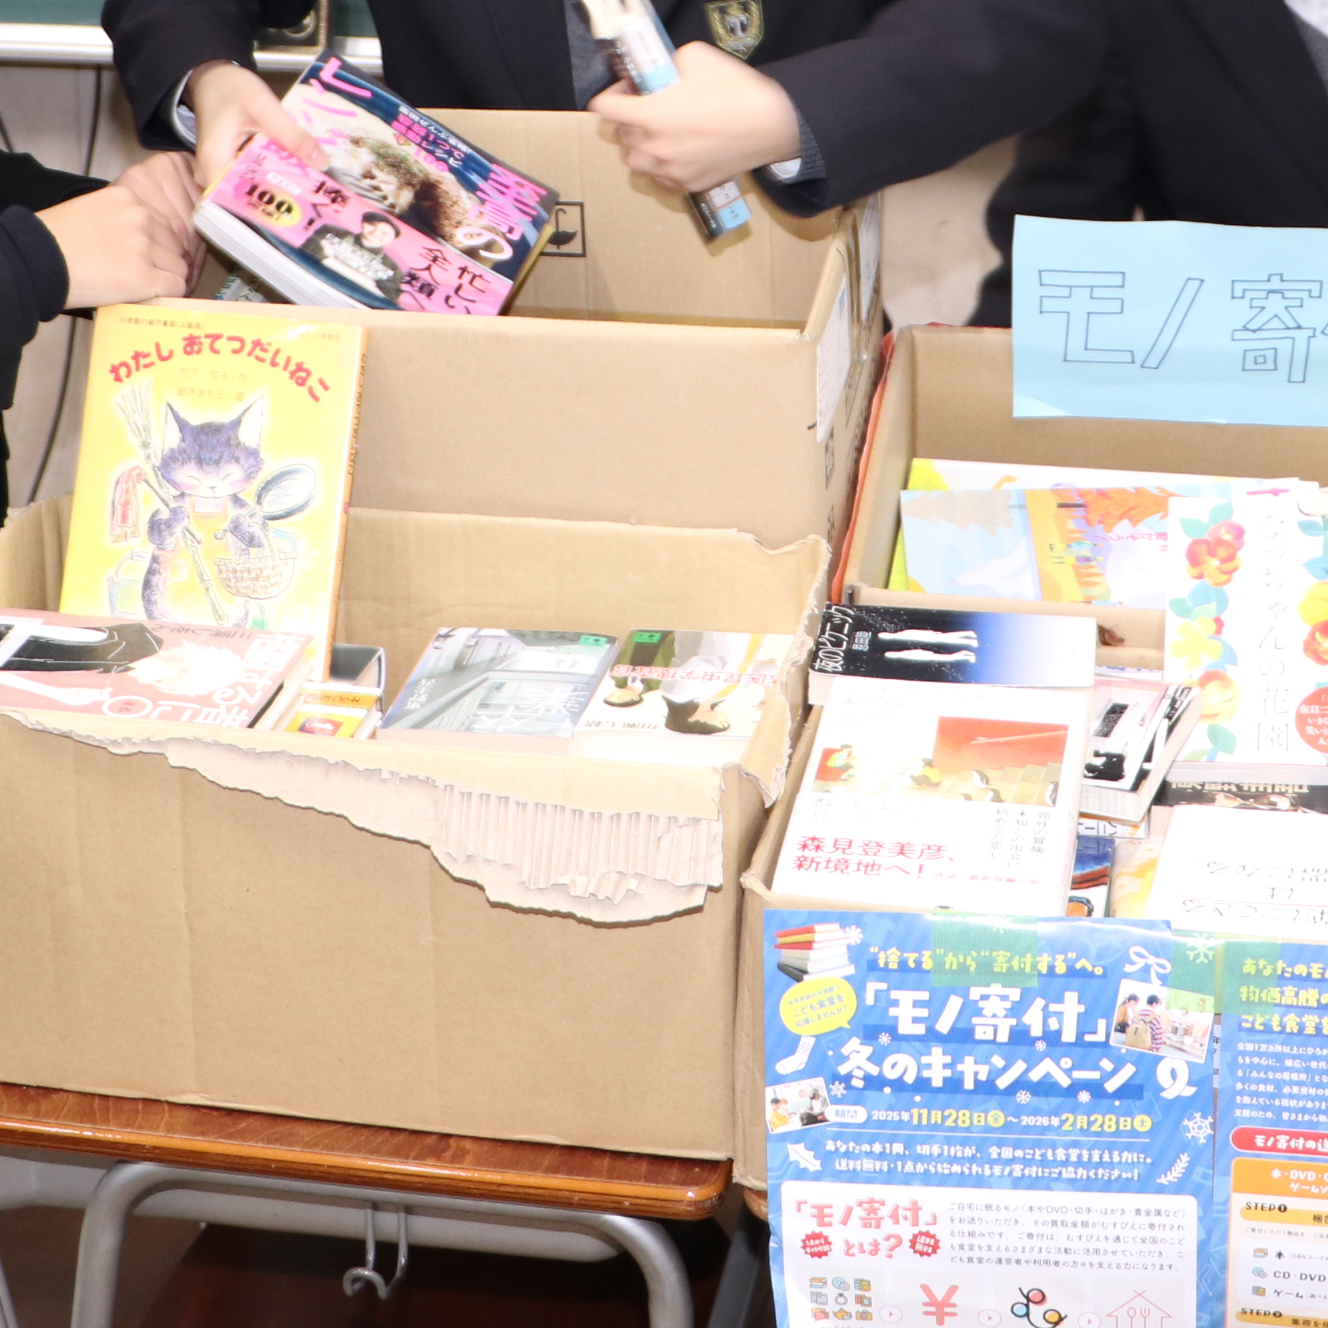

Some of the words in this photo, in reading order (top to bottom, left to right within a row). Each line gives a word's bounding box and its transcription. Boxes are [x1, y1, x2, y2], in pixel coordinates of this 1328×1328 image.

[108, 341, 175, 384] わたし
[182, 333, 331, 403] おてつだいねこ
[796, 835, 955, 862] 森見登美彦、
[865, 981, 1108, 1045] 「モノ寄付」
[837, 1036, 1137, 1095] 冬のキャンペーン
[795, 1197, 937, 1229] 「モノ寄付」
[843, 1232, 902, 1259] とは?
